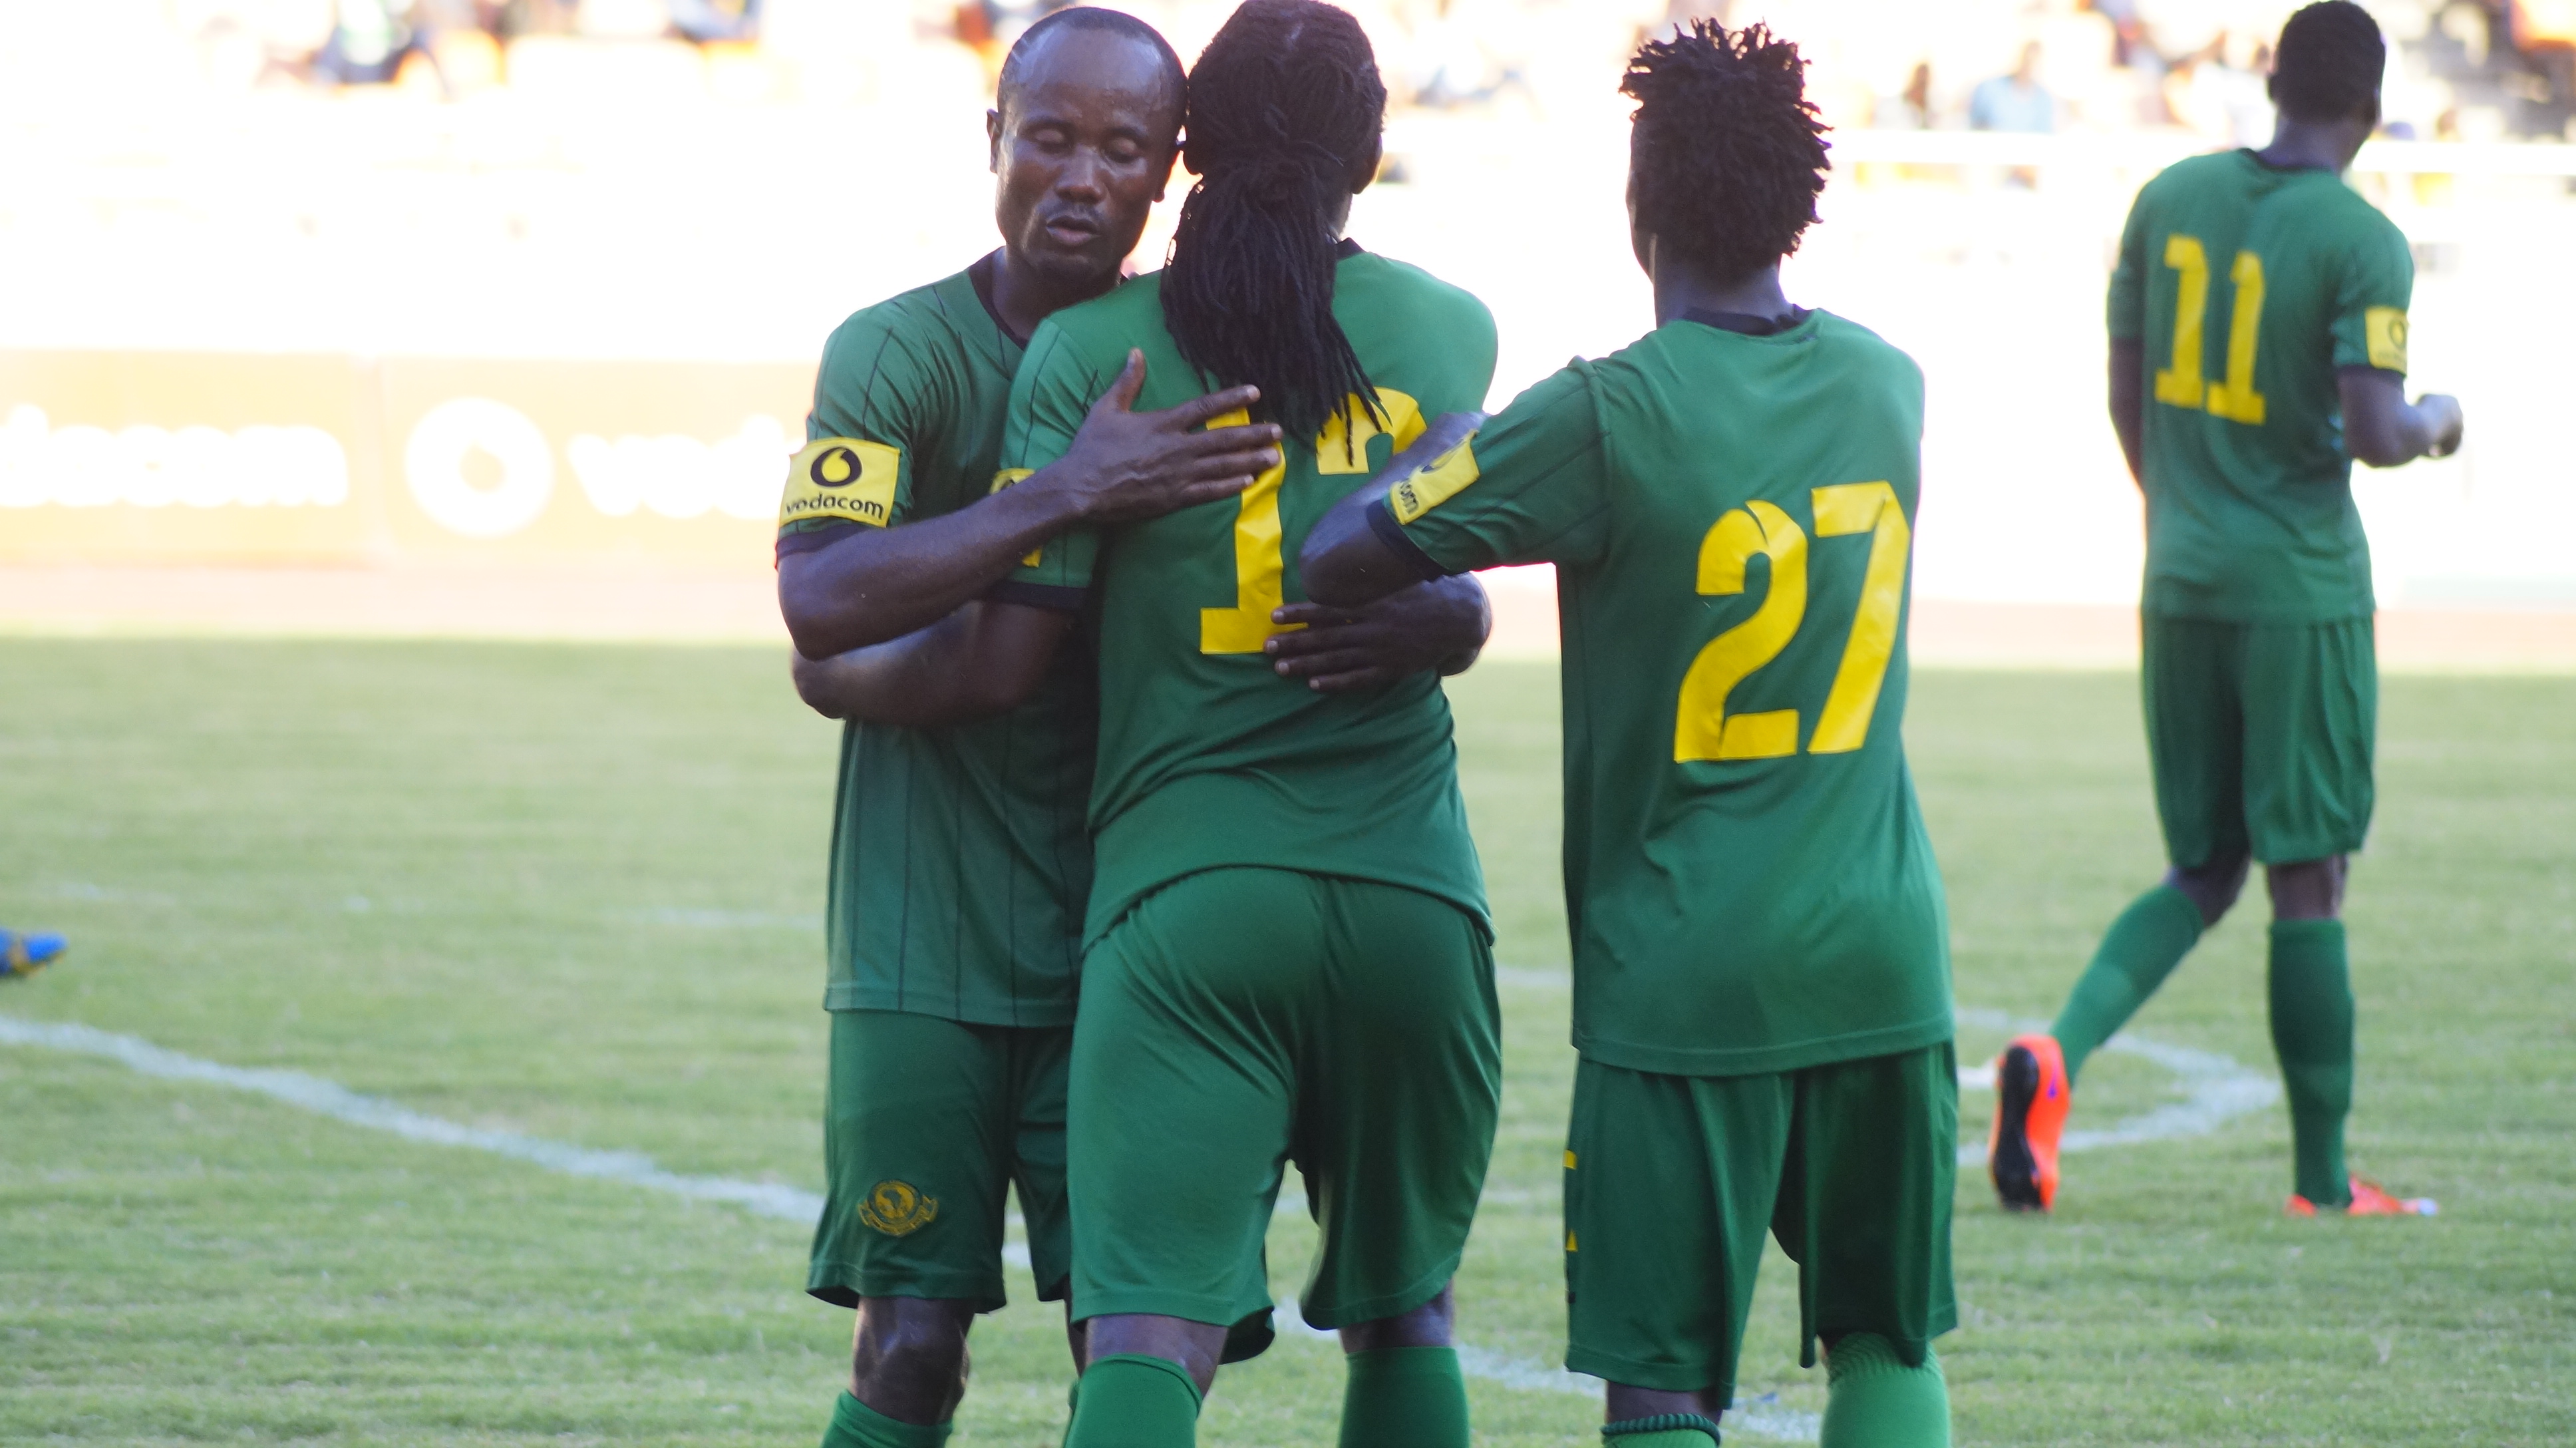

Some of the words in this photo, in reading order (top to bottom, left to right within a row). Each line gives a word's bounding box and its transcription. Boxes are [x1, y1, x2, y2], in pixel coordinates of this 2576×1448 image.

[2154, 232, 2267, 426] 11
[786, 492, 885, 520] vodacom
[1674, 480, 1911, 764] 27
